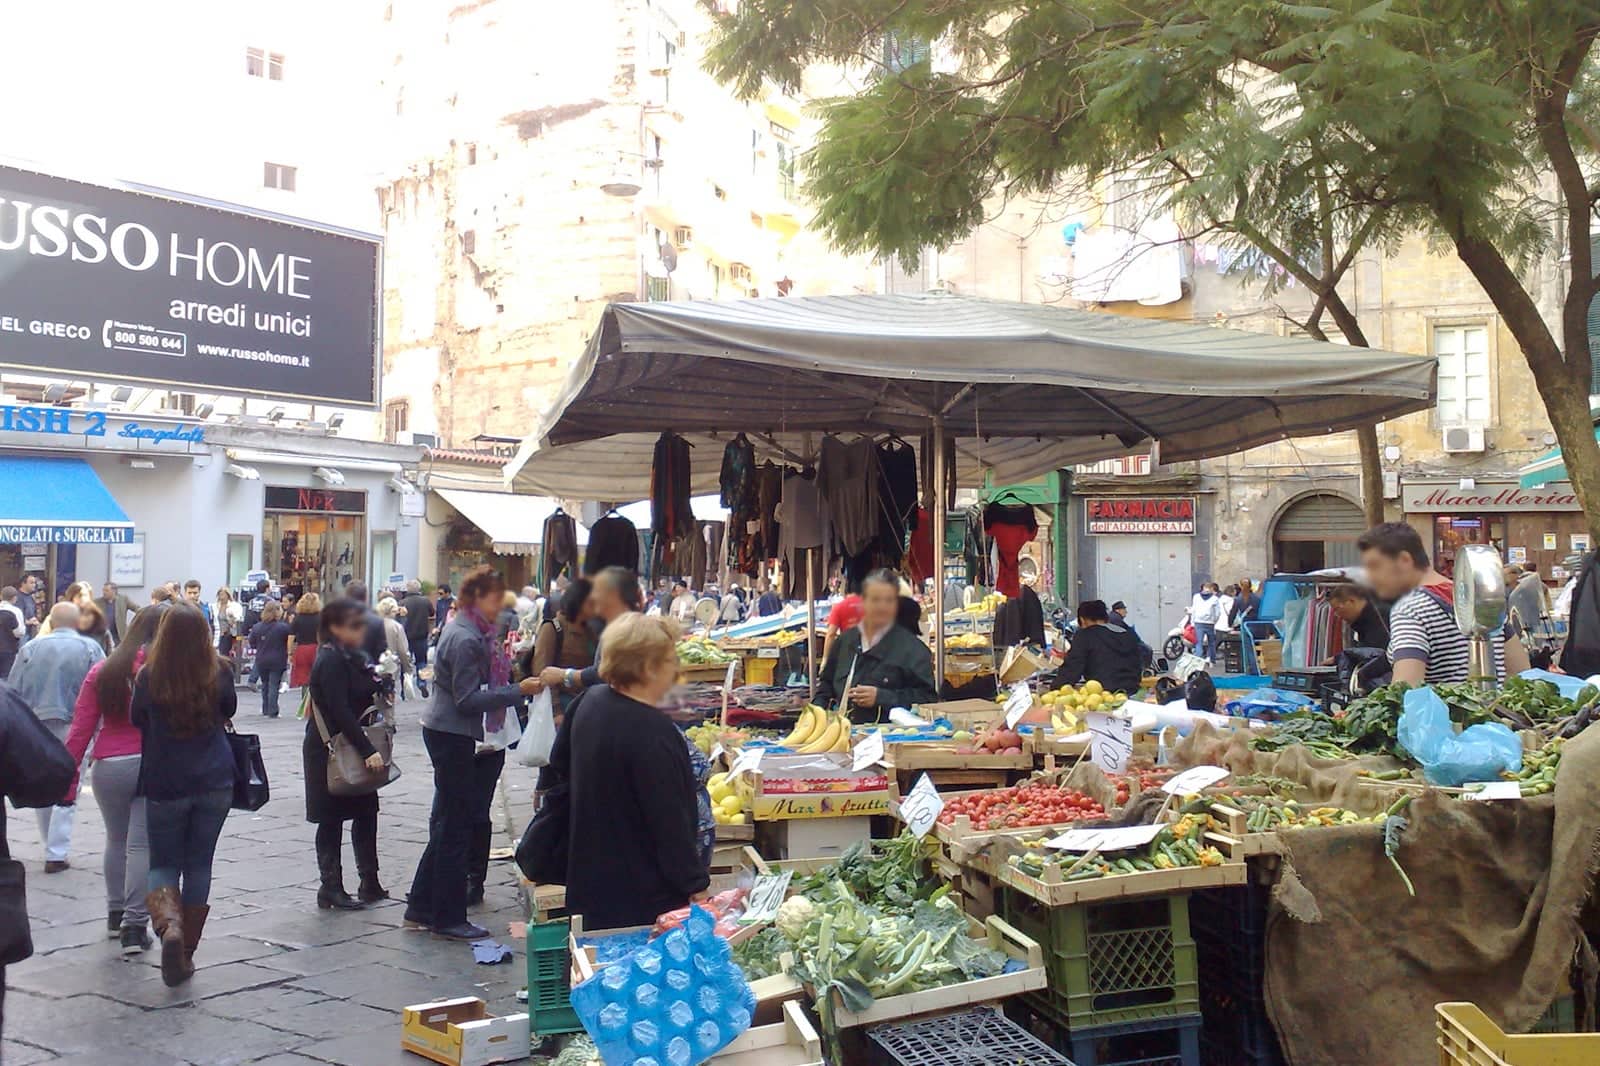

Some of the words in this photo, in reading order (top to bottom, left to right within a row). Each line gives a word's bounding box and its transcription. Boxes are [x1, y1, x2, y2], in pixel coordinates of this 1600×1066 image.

[169, 232, 312, 299] HOME
[0, 316, 24, 332] EL
[29, 320, 91, 340] GRECO
[169, 299, 246, 328] arredi
[254, 311, 311, 337] unici
[115, 331, 136, 344] 800
[139, 334, 159, 347] 500
[161, 337, 182, 350] 644
[196, 343, 310, 368] www.russohome.it
[84, 411, 106, 436] 2
[1088, 499, 1193, 519] FARMACIA
[1413, 488, 1577, 507] Macelleria
[55, 532, 60, 542] e
[63, 527, 126, 543] SURGELATI
